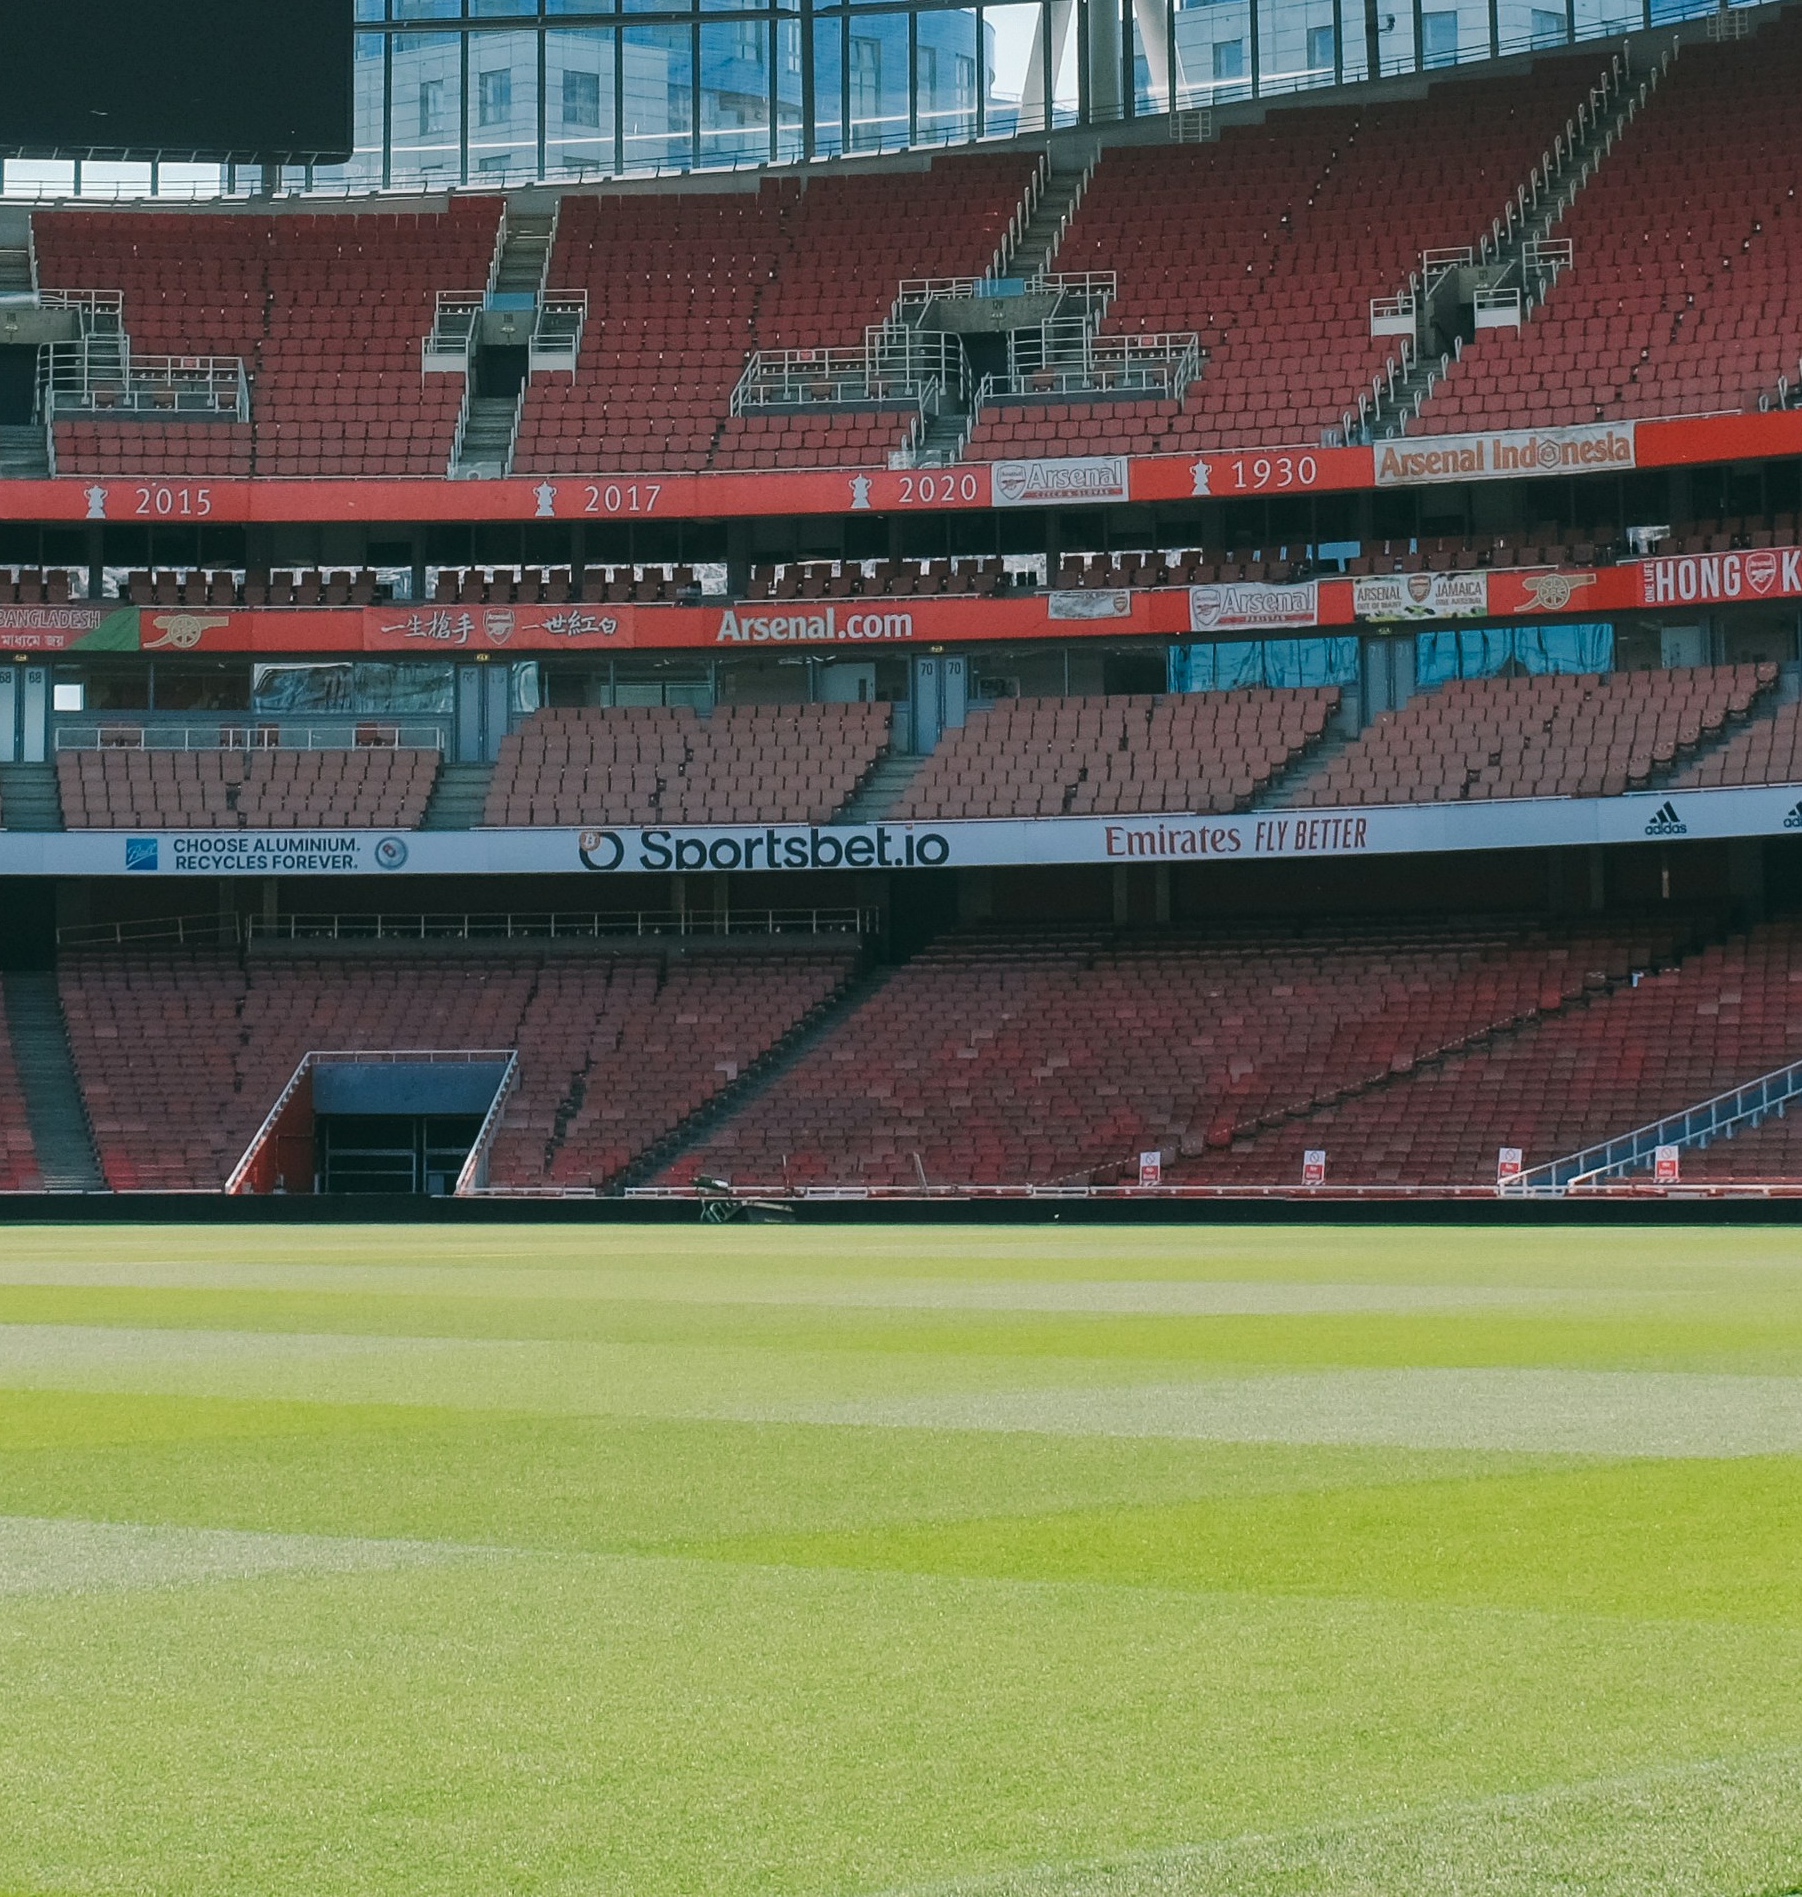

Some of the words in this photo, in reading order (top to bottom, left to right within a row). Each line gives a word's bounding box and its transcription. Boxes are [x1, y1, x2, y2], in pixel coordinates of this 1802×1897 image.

[1231, 456, 1318, 489] 1930
[1379, 440, 1484, 478] Arsenal
[899, 474, 977, 502] 2020
[1027, 460, 1122, 489] Arsenal
[135, 488, 212, 516] 2015
[583, 485, 662, 512] 2017
[1357, 586, 1402, 601] ARSENAL
[1435, 582, 1482, 598] JAMAICA
[1656, 554, 1741, 602] HONG
[1221, 584, 1315, 614] Arsenal
[716, 607, 912, 641] Arsenal.com
[28, 671, 41, 683] 68
[921, 663, 933, 675] 70
[949, 662, 961, 674] 70
[1105, 824, 1241, 856] Emirates
[1256, 820, 1289, 851] FLY
[1295, 818, 1367, 850] BETTER
[1645, 822, 1687, 835] adidas
[173, 838, 248, 853] CHOOSE
[253, 837, 361, 853] ALUMINIUM.
[639, 827, 949, 870] Sportsbet.io
[176, 855, 267, 869] RECYCLES
[272, 855, 358, 869] FOREVER.
